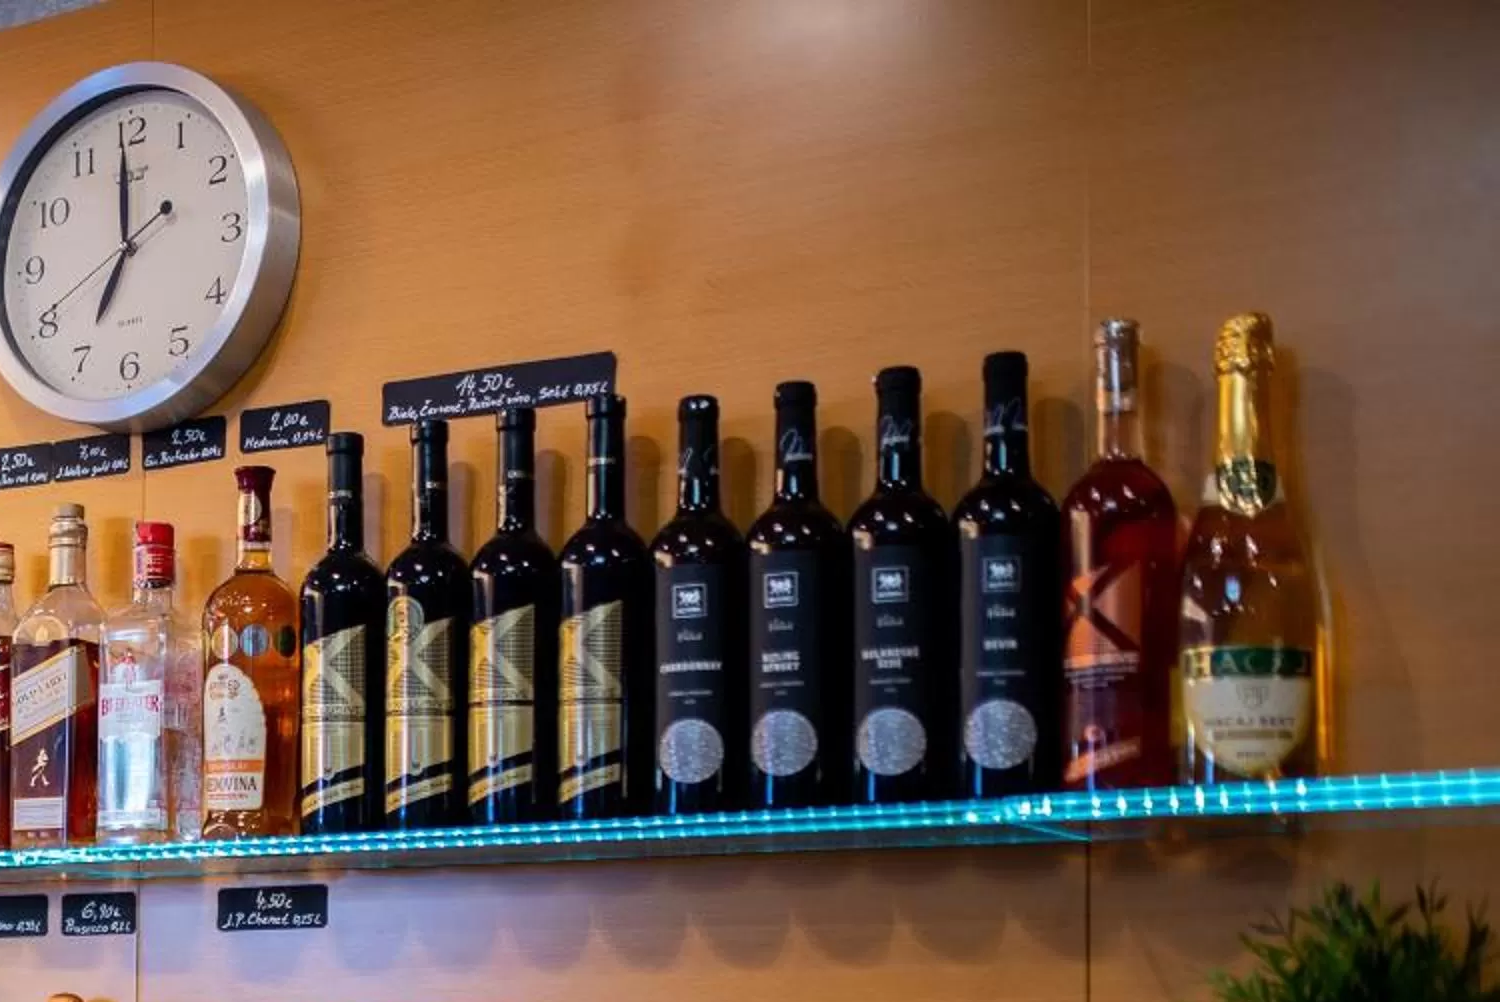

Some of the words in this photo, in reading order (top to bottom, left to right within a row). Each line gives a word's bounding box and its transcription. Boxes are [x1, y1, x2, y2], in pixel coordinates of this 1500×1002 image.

[117, 117, 147, 149] 12
[176, 121, 187, 150] 1
[72, 147, 95, 178] 11
[208, 155, 228, 185] 2
[39, 197, 71, 229] 10
[220, 212, 242, 243] 3
[25, 256, 46, 285] 9
[205, 276, 227, 305] 4
[38, 308, 59, 339] 8
[168, 325, 190, 356] 5
[72, 345, 93, 374] 7
[119, 351, 141, 381] 6
